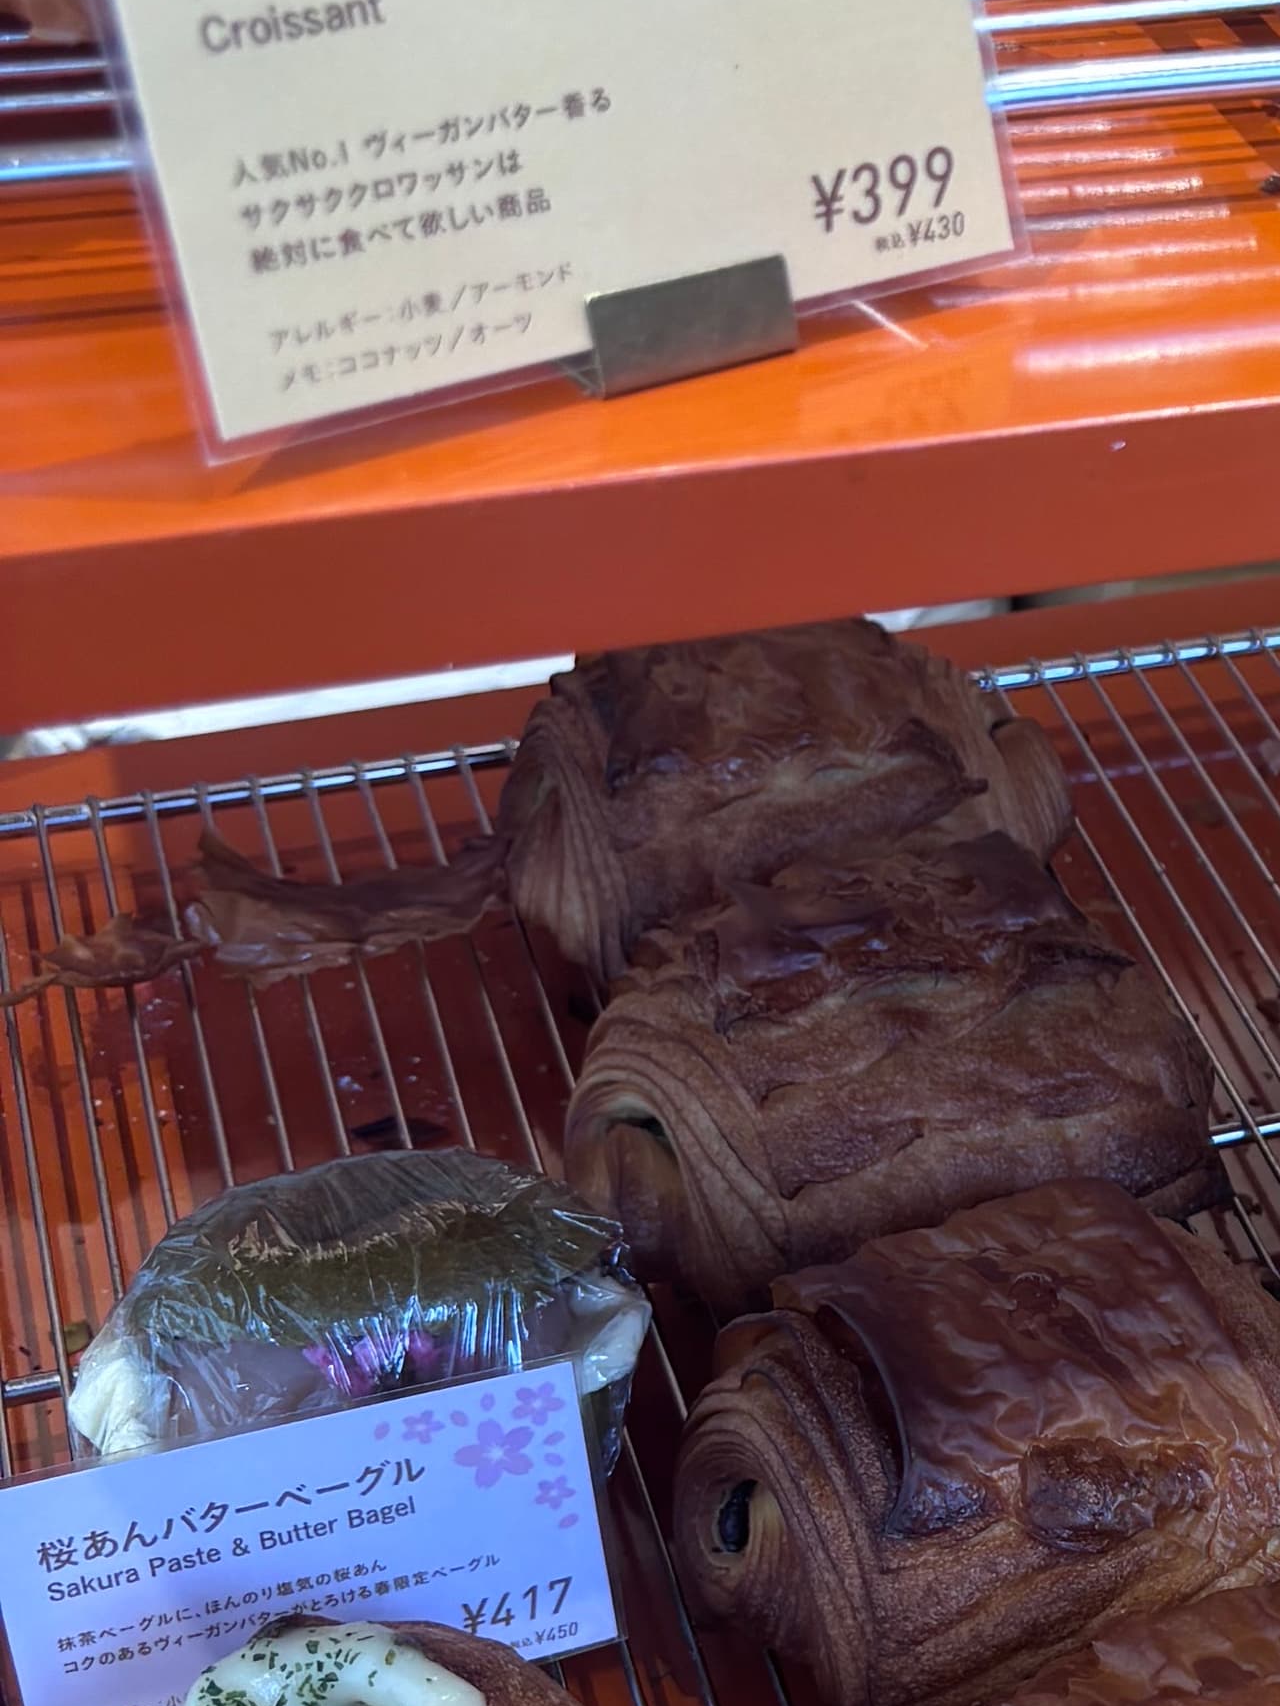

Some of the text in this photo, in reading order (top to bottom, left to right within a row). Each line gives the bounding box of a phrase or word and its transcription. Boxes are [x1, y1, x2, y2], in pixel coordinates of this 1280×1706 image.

[239, 149, 523, 229] サクサククロワッサンは
[250, 187, 551, 274] 絶対に食べて欲しい商品
[811, 146, 956, 235] ¥399
[37, 1457, 426, 1574] 桜あんバターベーグル
[46, 1496, 417, 1603] Sakura Paste & Butter Bagel
[56, 1559, 388, 1653] 抹茶ベーグルに、ほんのり塩気の桜あん
[462, 1576, 573, 1635] ¥417
